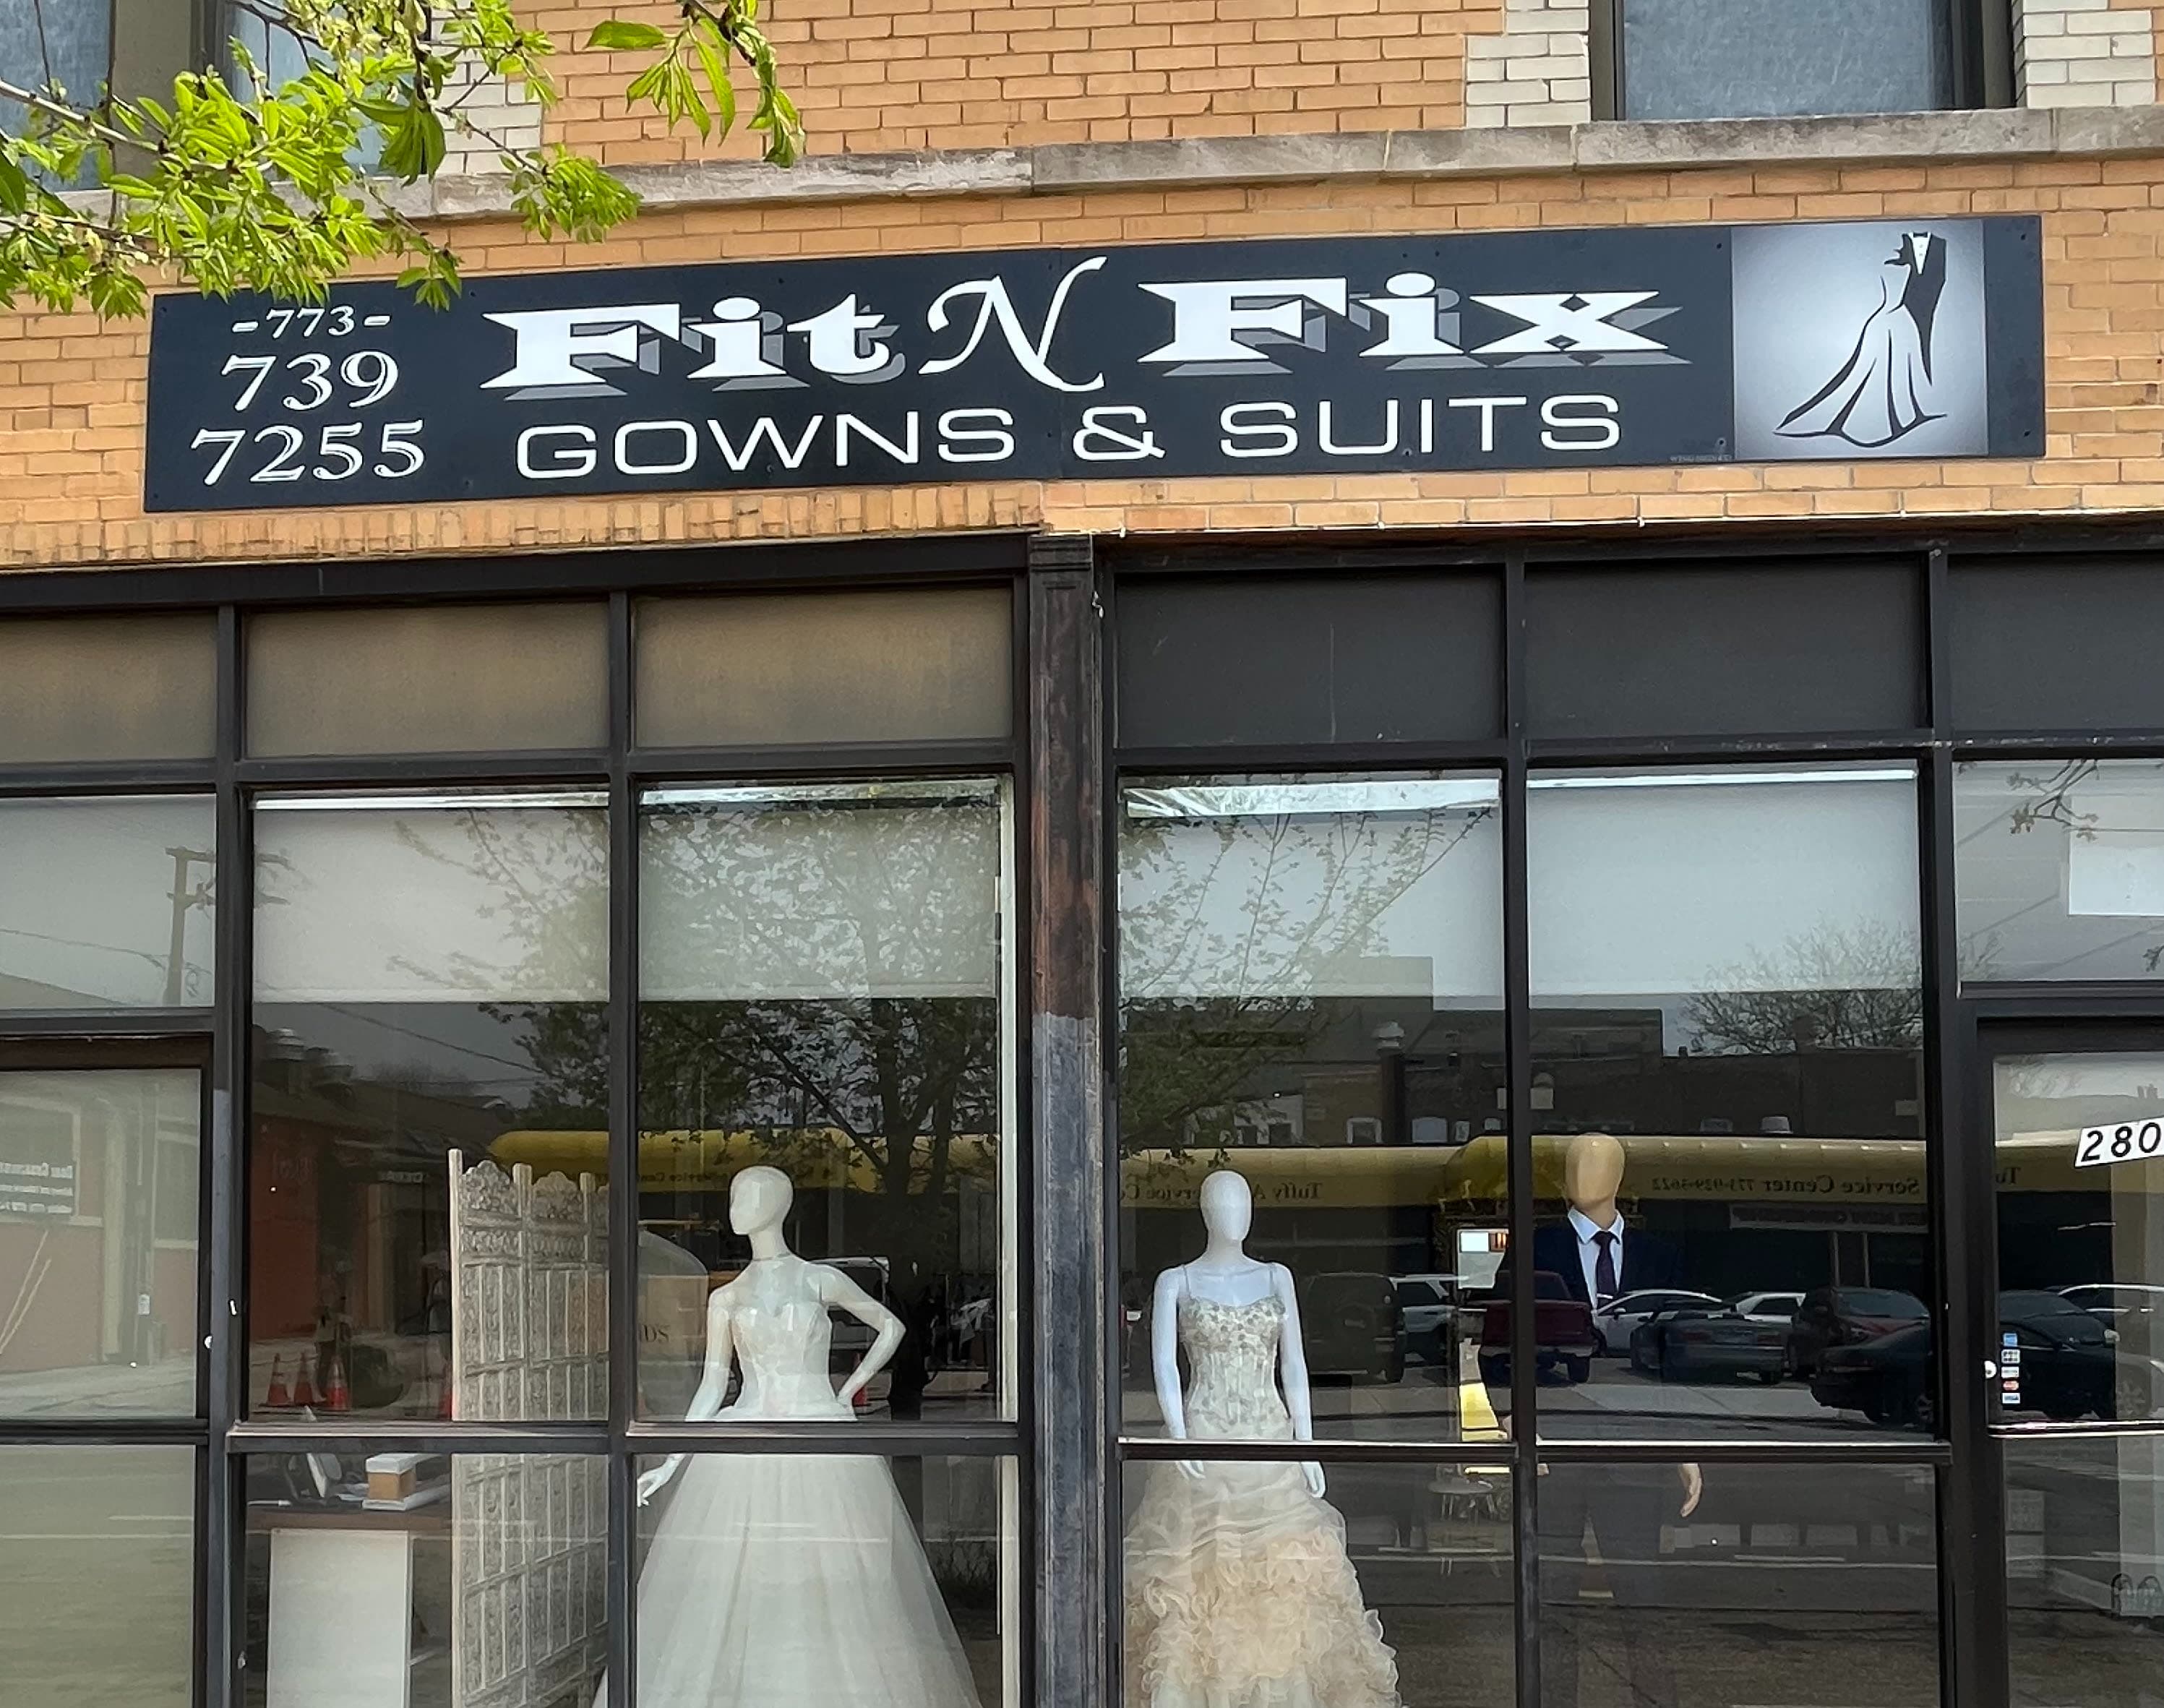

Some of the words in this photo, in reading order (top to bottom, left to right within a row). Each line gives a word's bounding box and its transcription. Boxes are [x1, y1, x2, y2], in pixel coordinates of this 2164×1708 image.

[479, 293, 896, 394] Fit
[918, 256, 1107, 392] N
[1137, 272, 1675, 369] Fix
[220, 350, 400, 412] 739
[190, 419, 426, 486] 7255
[515, 408, 1016, 480] GOWNS
[1072, 405, 1166, 462] &
[1220, 394, 1622, 458] SUITS
[2080, 1122, 2162, 1163] 280
